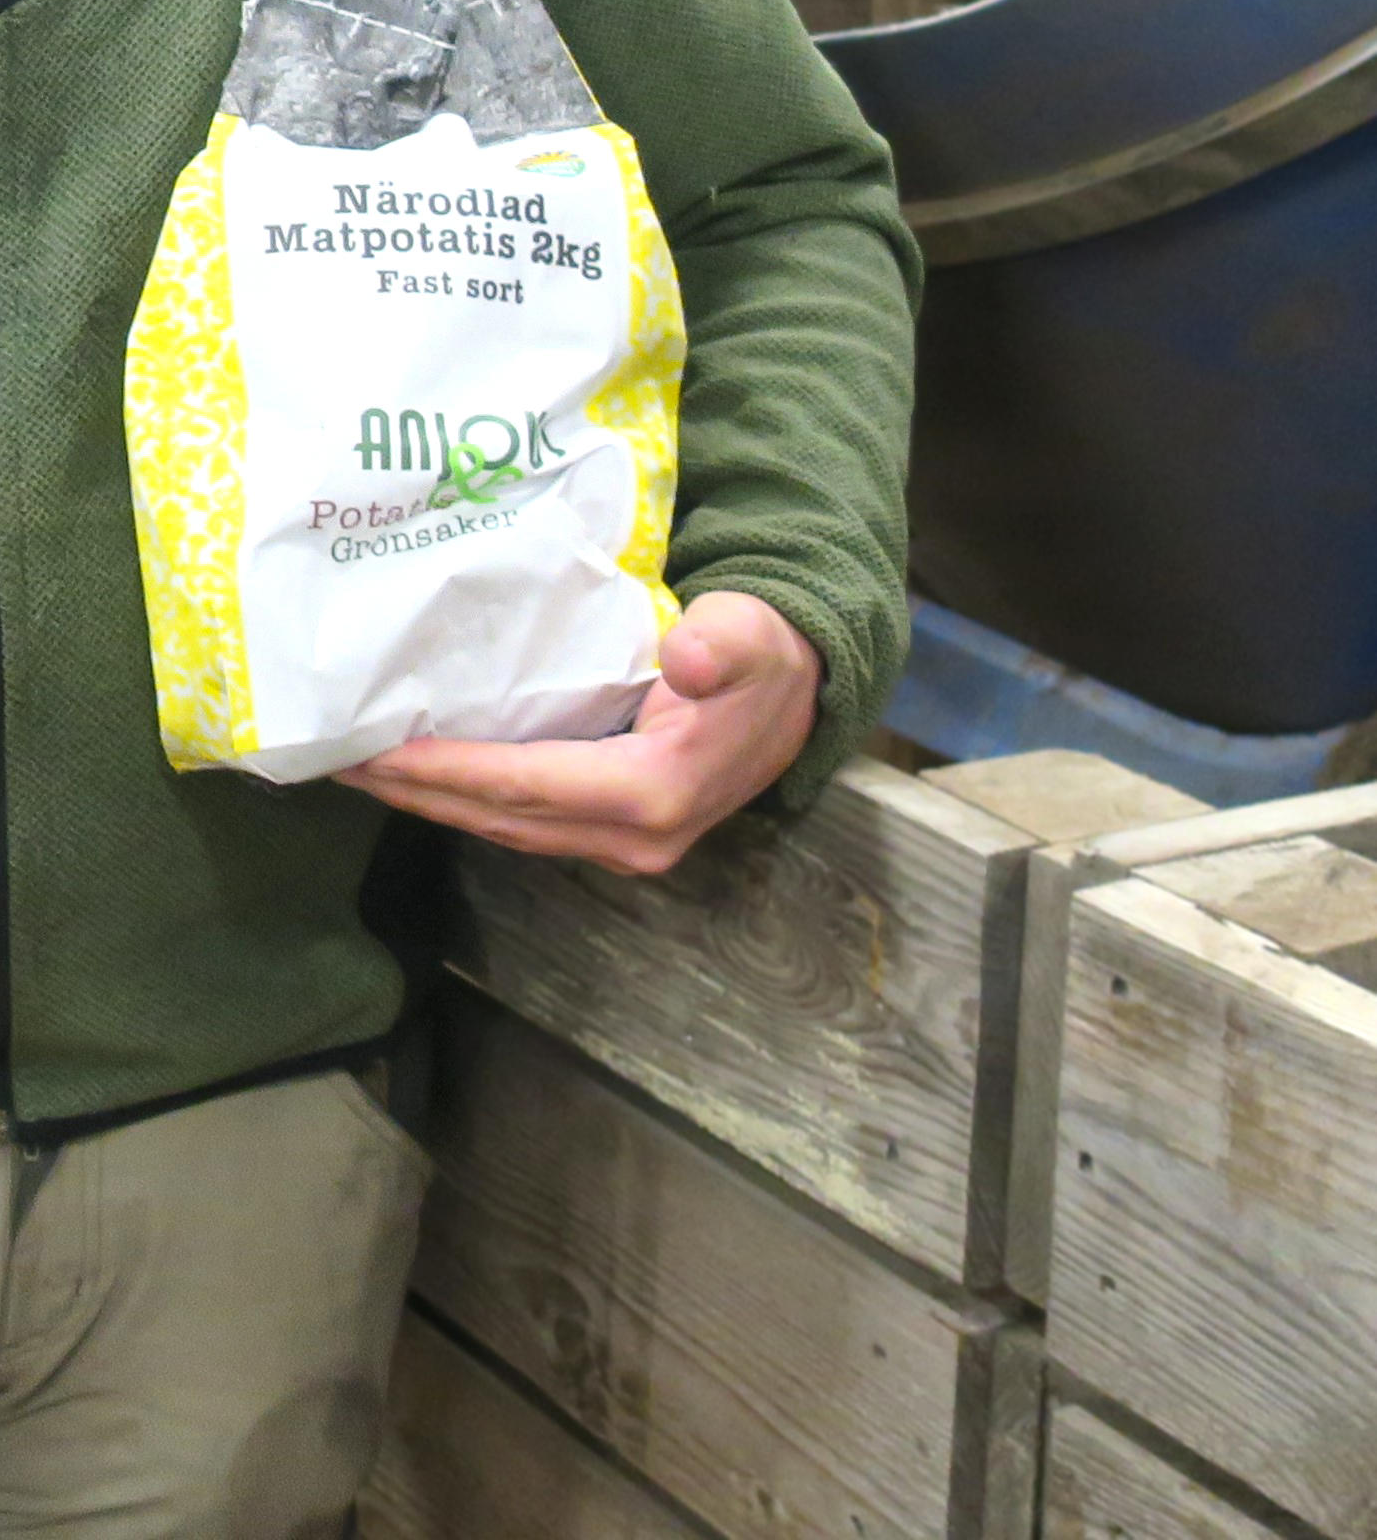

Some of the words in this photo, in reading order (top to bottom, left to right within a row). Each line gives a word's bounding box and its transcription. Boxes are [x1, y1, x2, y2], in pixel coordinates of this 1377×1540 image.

[332, 180, 549, 225] Närodlad
[263, 221, 517, 260] Matpotatis
[530, 230, 604, 281] 2kg
[376, 269, 454, 296] Fast
[465, 276, 525, 305] sort
[329, 507, 519, 564] Grönsaker
